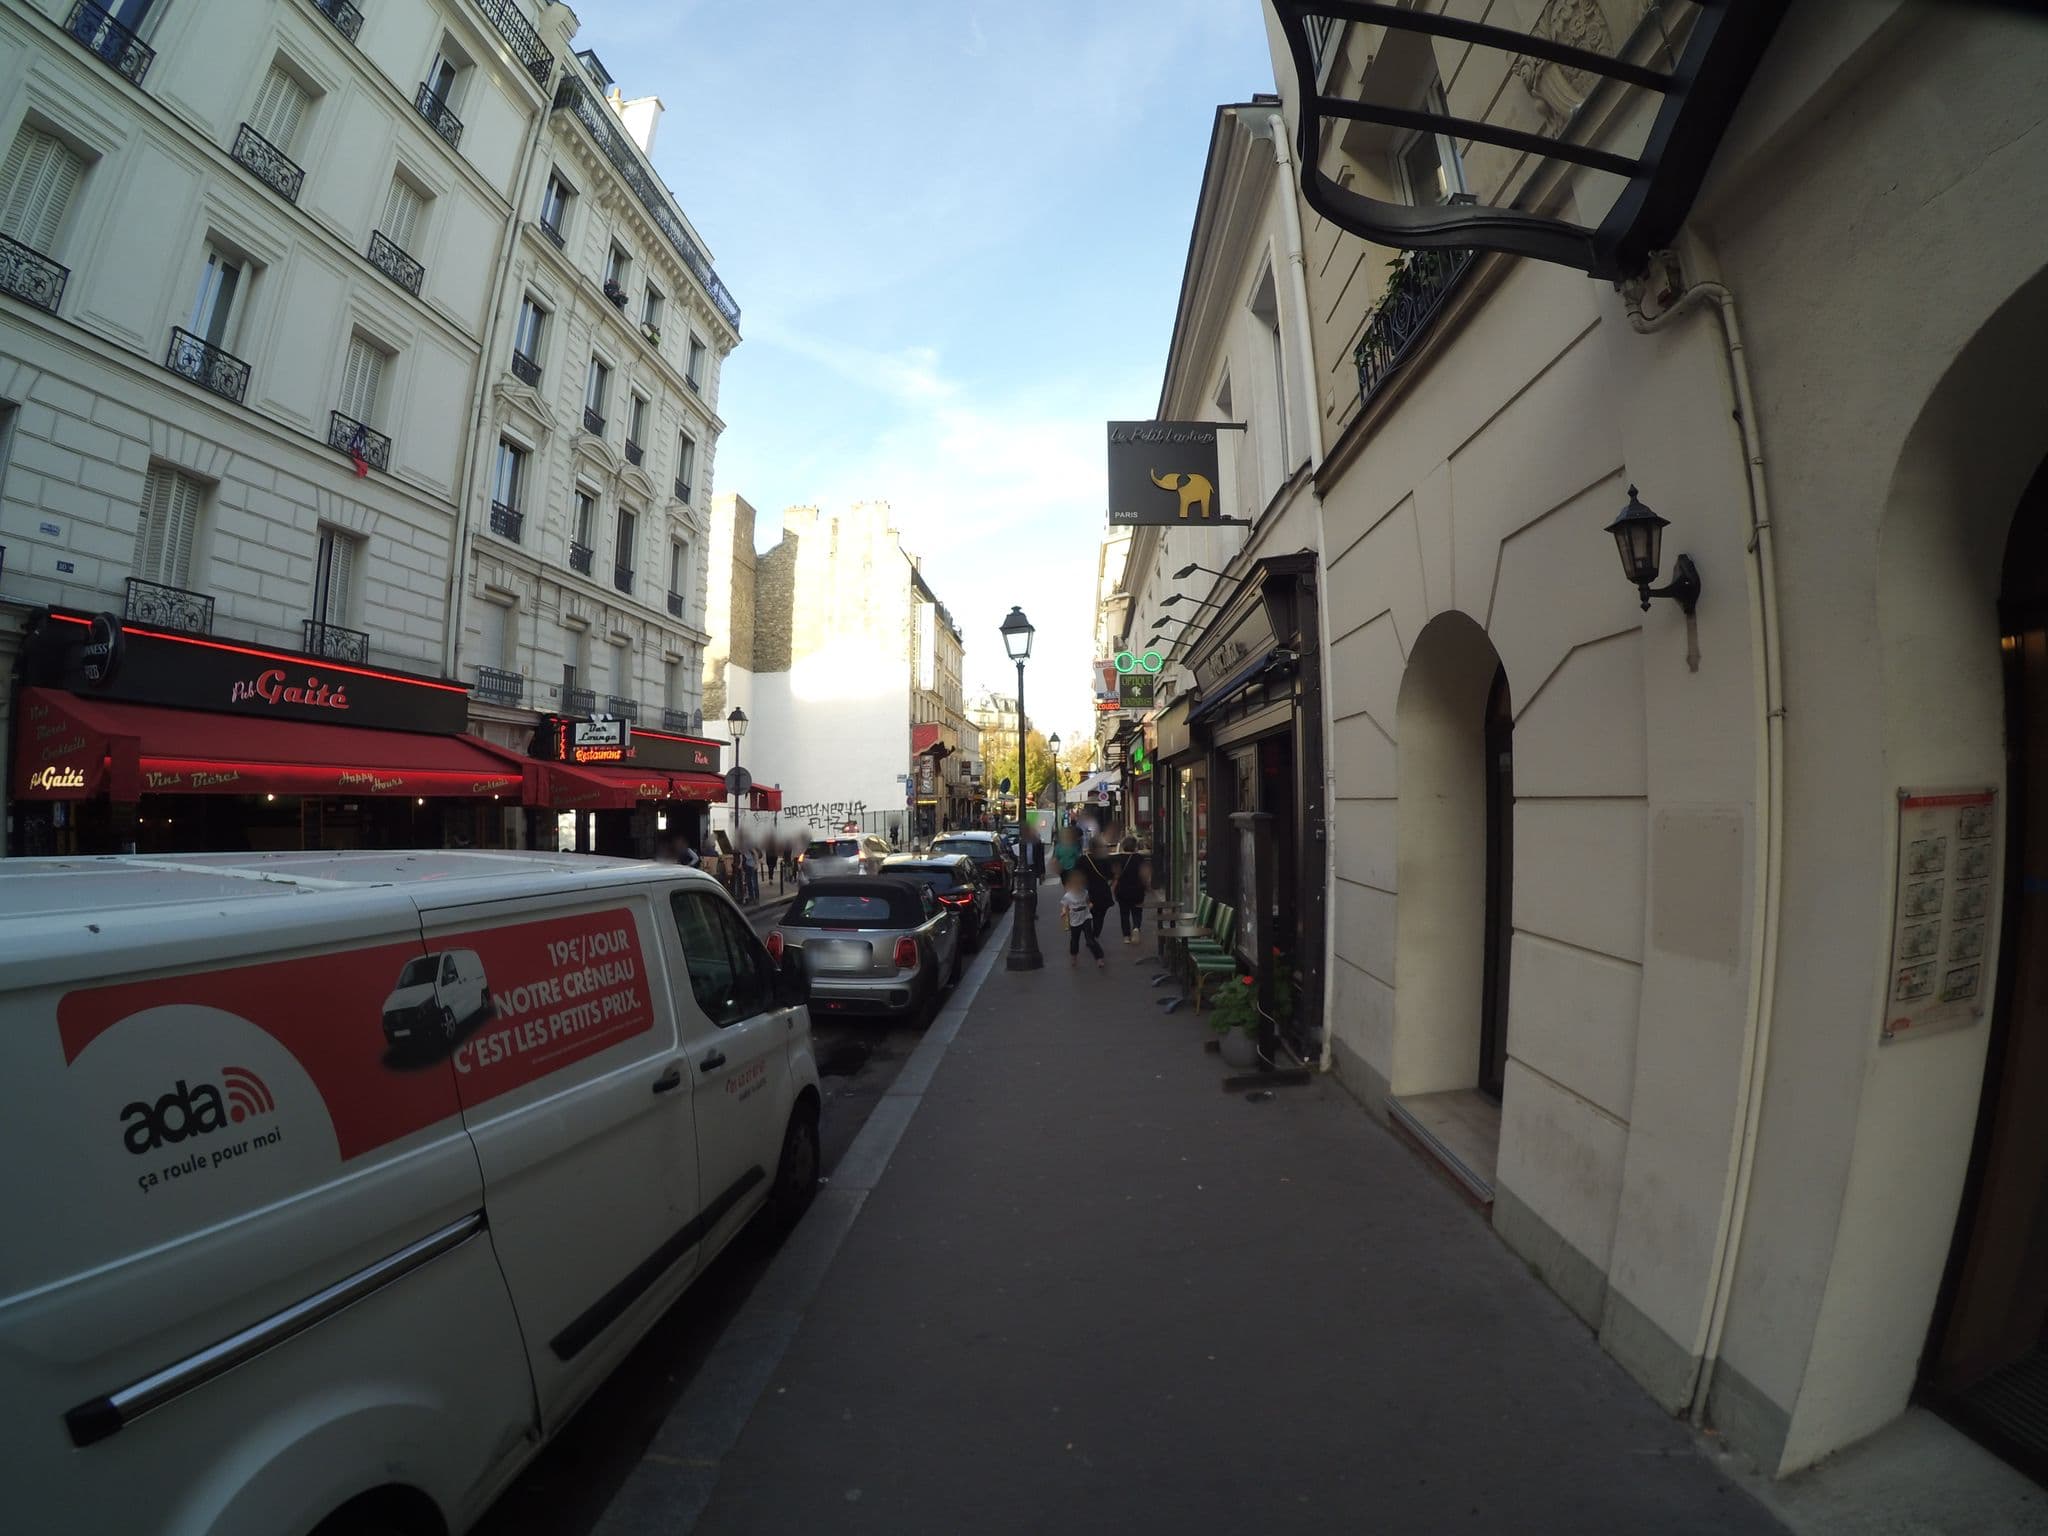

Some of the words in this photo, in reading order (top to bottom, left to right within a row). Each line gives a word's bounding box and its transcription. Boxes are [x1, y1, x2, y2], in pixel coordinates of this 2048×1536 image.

[1114, 511, 1139, 519] PARIS
[231, 679, 257, 704] Pub
[256, 669, 350, 710] Gaité
[578, 732, 618, 743] Lounge
[587, 723, 608, 734] Bar
[575, 749, 621, 763] Restaurant
[693, 750, 709, 765] Bar
[41, 766, 85, 790] Gaité
[146, 771, 182, 788] Vins
[338, 770, 374, 785] Happy
[371, 777, 404, 793] Hours
[472, 778, 509, 793] Cocktails
[493, 976, 563, 1020] NOTRE
[563, 957, 635, 998] CRÉNEAU
[453, 1027, 512, 1074] C'EST
[514, 1017, 548, 1054] LES
[548, 1000, 601, 1041] PETITS
[602, 987, 642, 1020] PRIX.
[120, 1079, 228, 1155] ada
[138, 1172, 159, 1194] ça
[163, 1153, 208, 1182] roule
[211, 1140, 249, 1169] pour
[253, 1125, 282, 1149] moi
